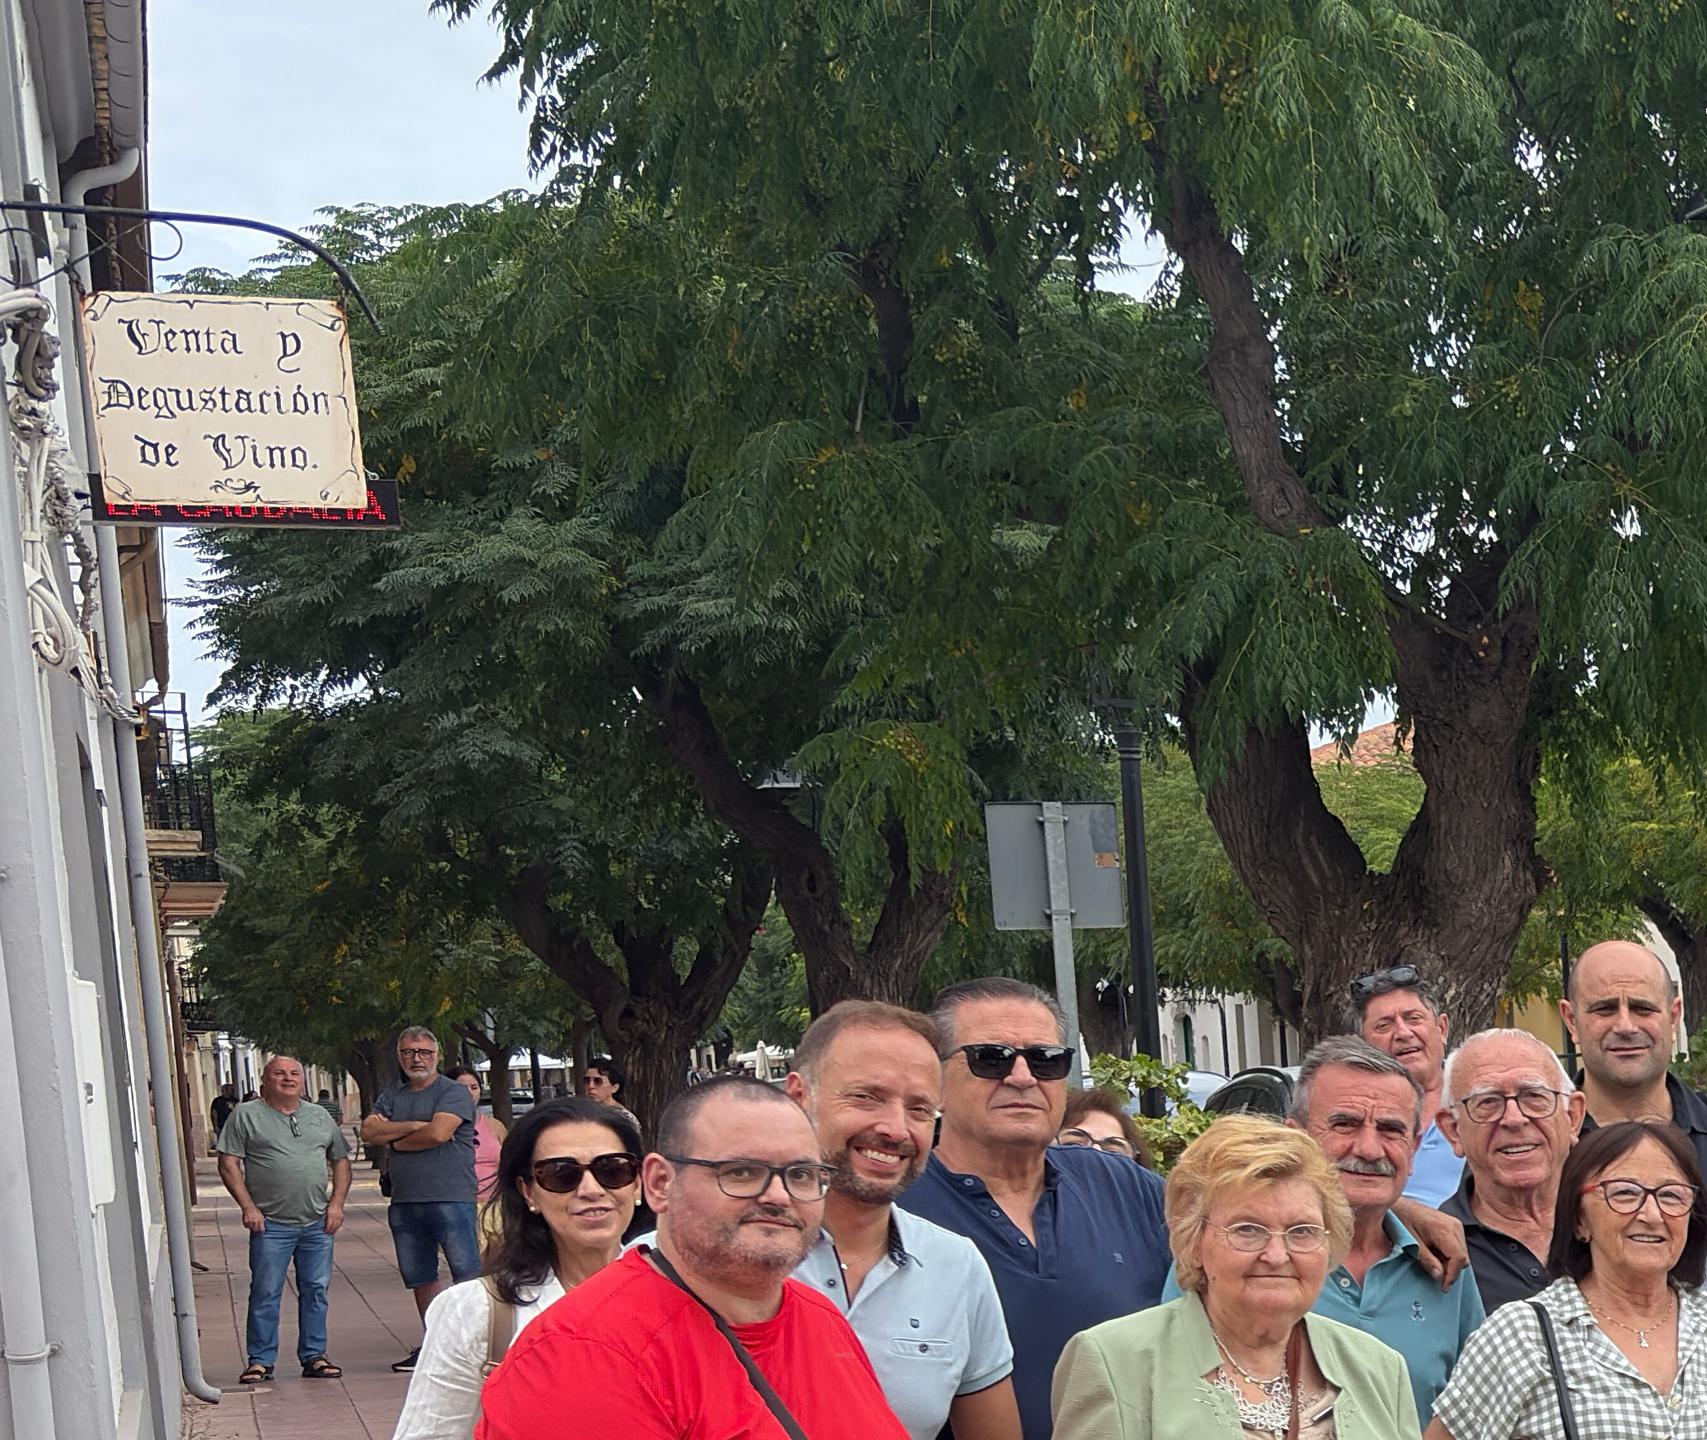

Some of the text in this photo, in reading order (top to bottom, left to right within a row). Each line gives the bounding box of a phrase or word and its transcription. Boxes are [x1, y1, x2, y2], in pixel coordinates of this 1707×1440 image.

[117, 318, 302, 373] Venta y
[98, 377, 330, 419] Degustación
[134, 433, 320, 471] de Vino.
